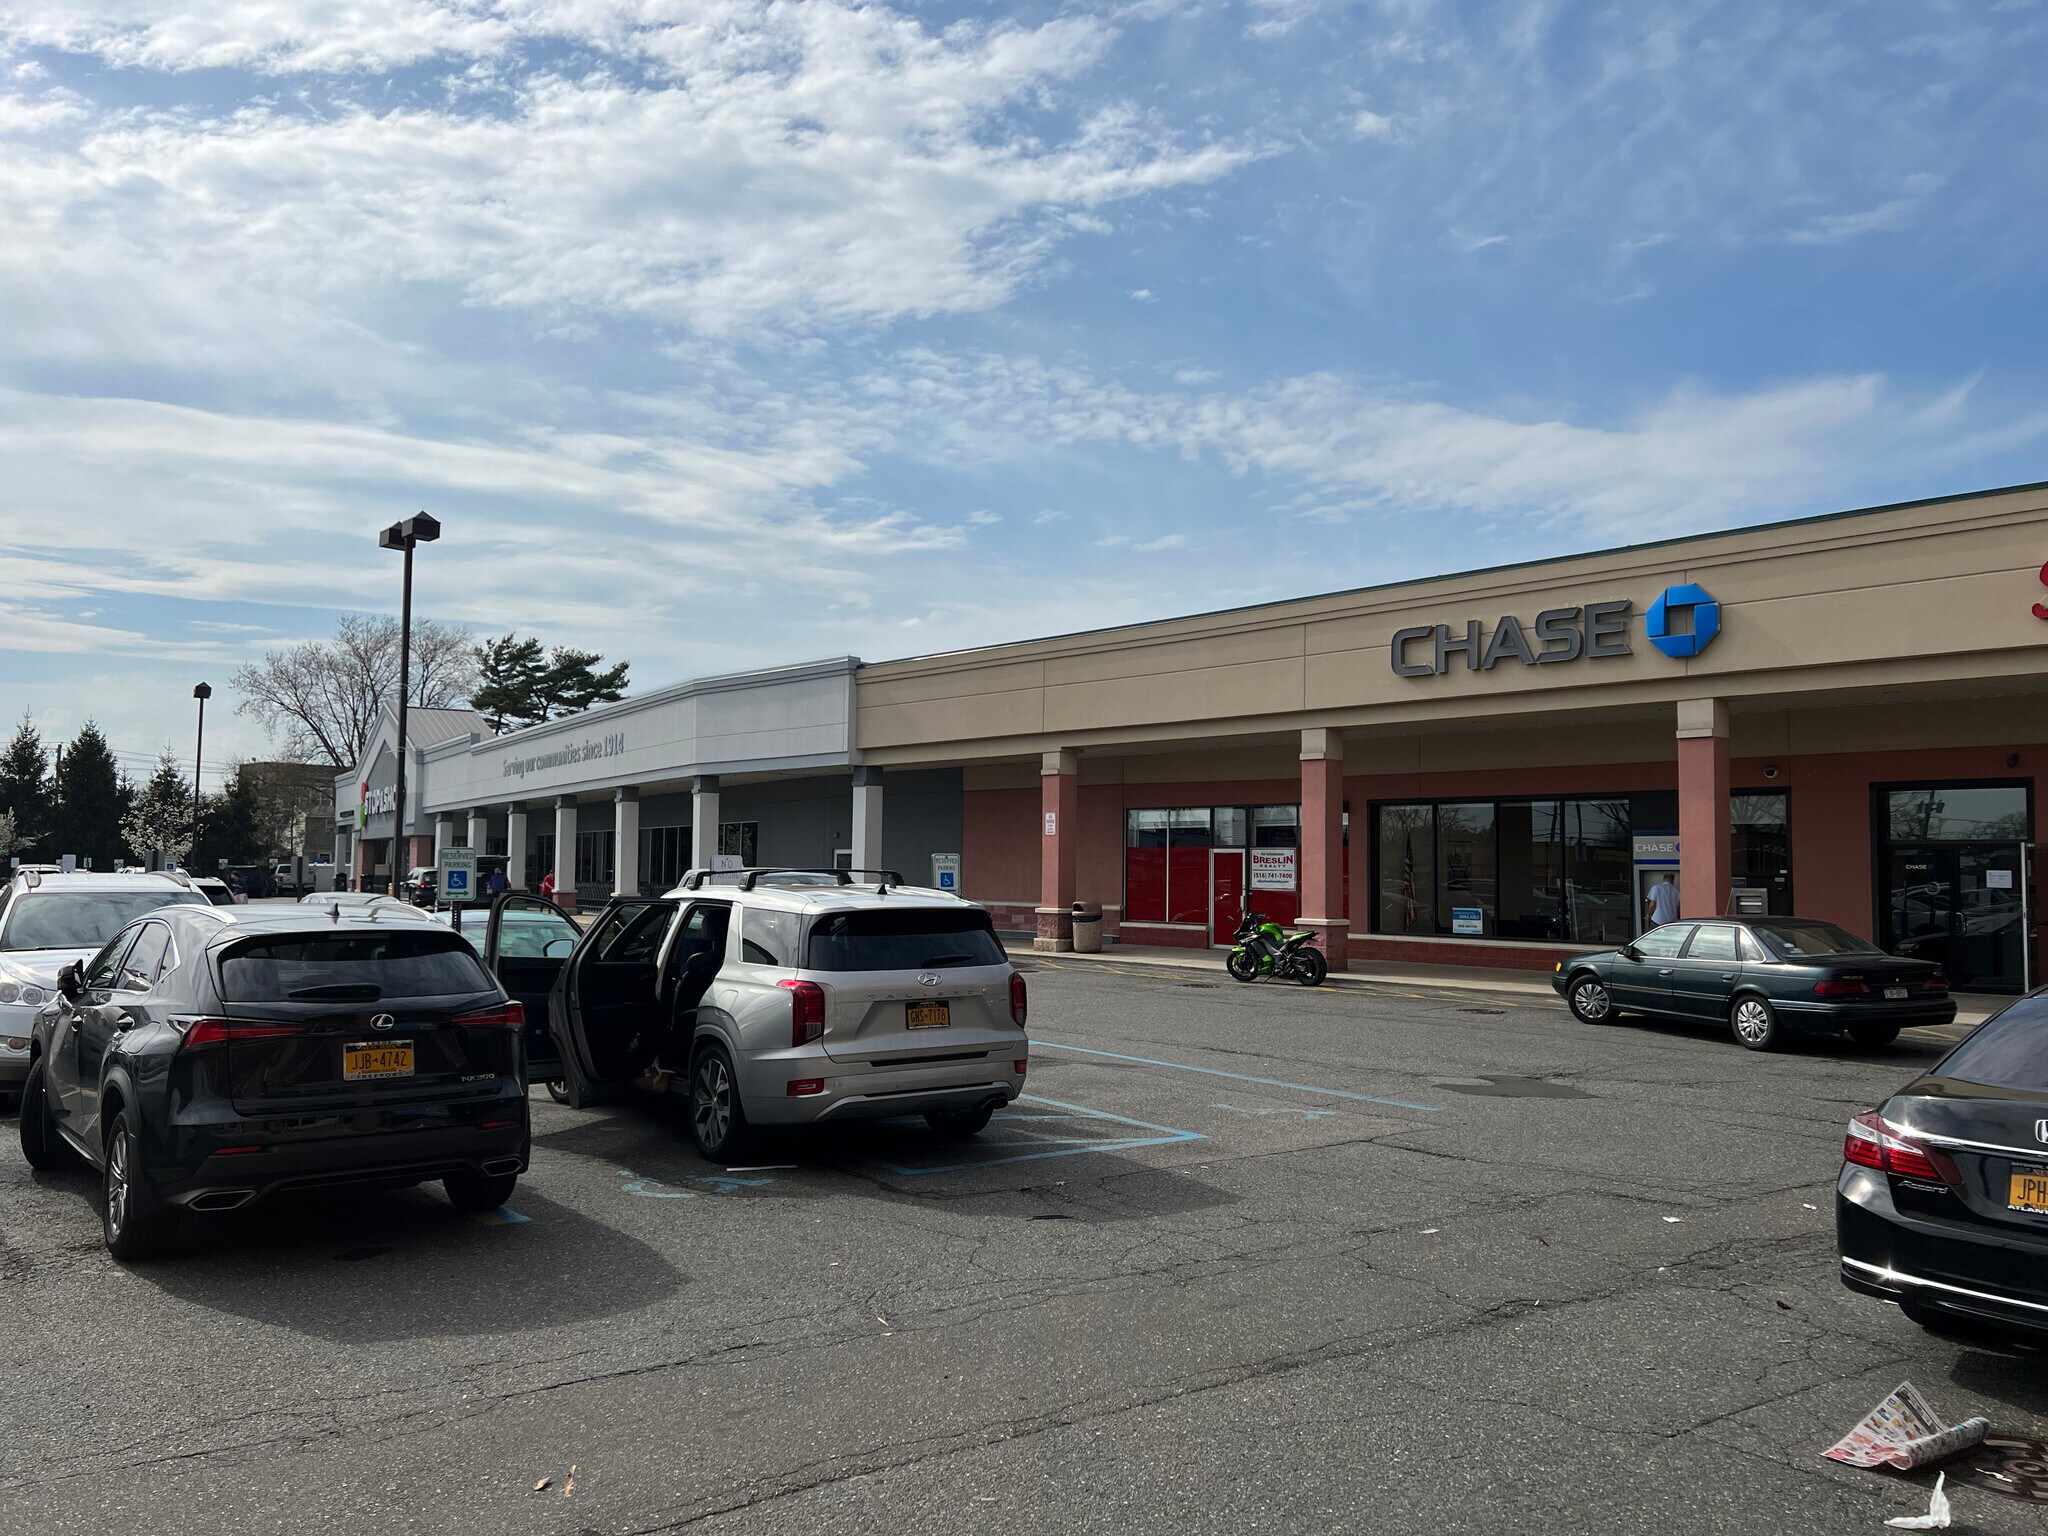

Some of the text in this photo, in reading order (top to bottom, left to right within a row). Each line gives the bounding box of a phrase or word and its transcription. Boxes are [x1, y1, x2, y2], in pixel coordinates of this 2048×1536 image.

[1390, 599, 1633, 677] CHASE
[502, 732, 624, 779] Serving our communities since 1914
[364, 784, 397, 816] STOP&SHO
[1635, 843, 1674, 853] CHASE
[441, 852, 474, 860] RESERVED
[1253, 855, 1293, 864] BRESLIN
[444, 861, 472, 869] PARKING
[721, 860, 733, 869] NO
[1897, 1180, 1949, 1194] Accord
